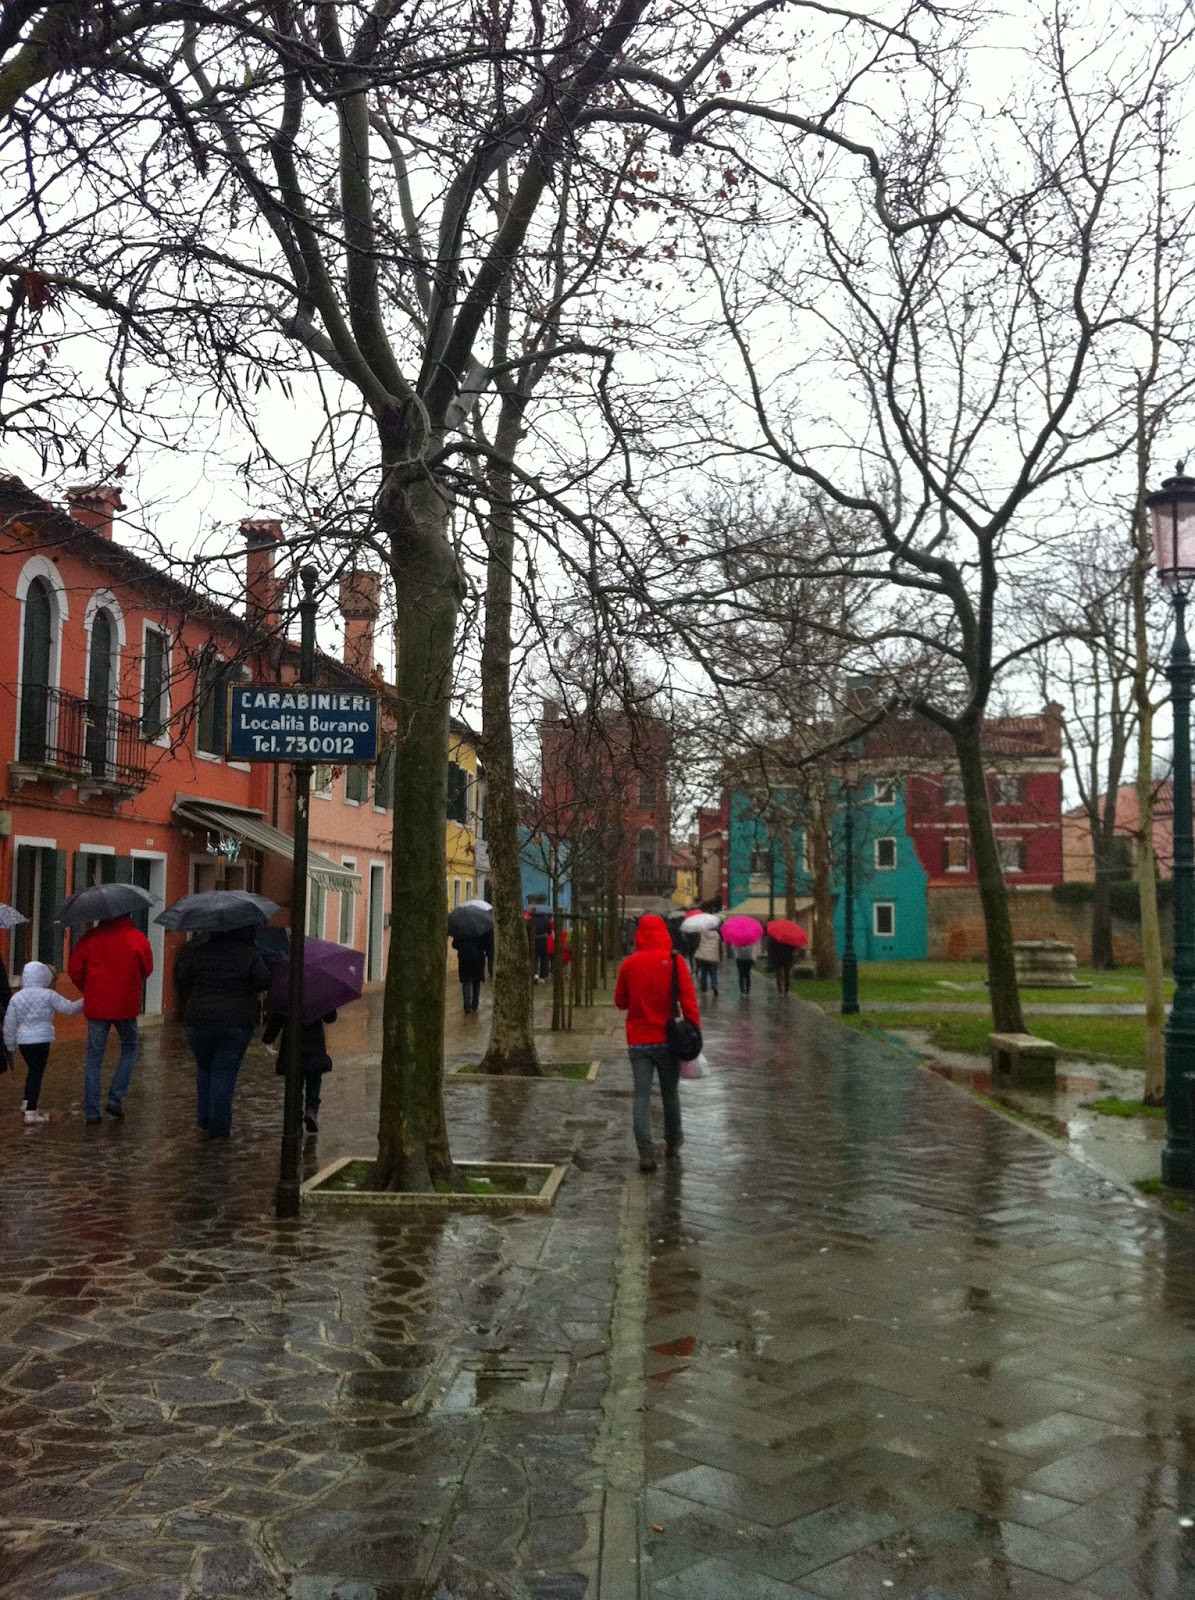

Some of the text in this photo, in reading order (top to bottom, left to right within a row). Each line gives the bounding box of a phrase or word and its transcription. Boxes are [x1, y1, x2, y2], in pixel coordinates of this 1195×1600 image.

[241, 692, 371, 711] CARABINIERI
[240, 713, 370, 733] Località Burano
[252, 735, 355, 754] Tel. 730012
